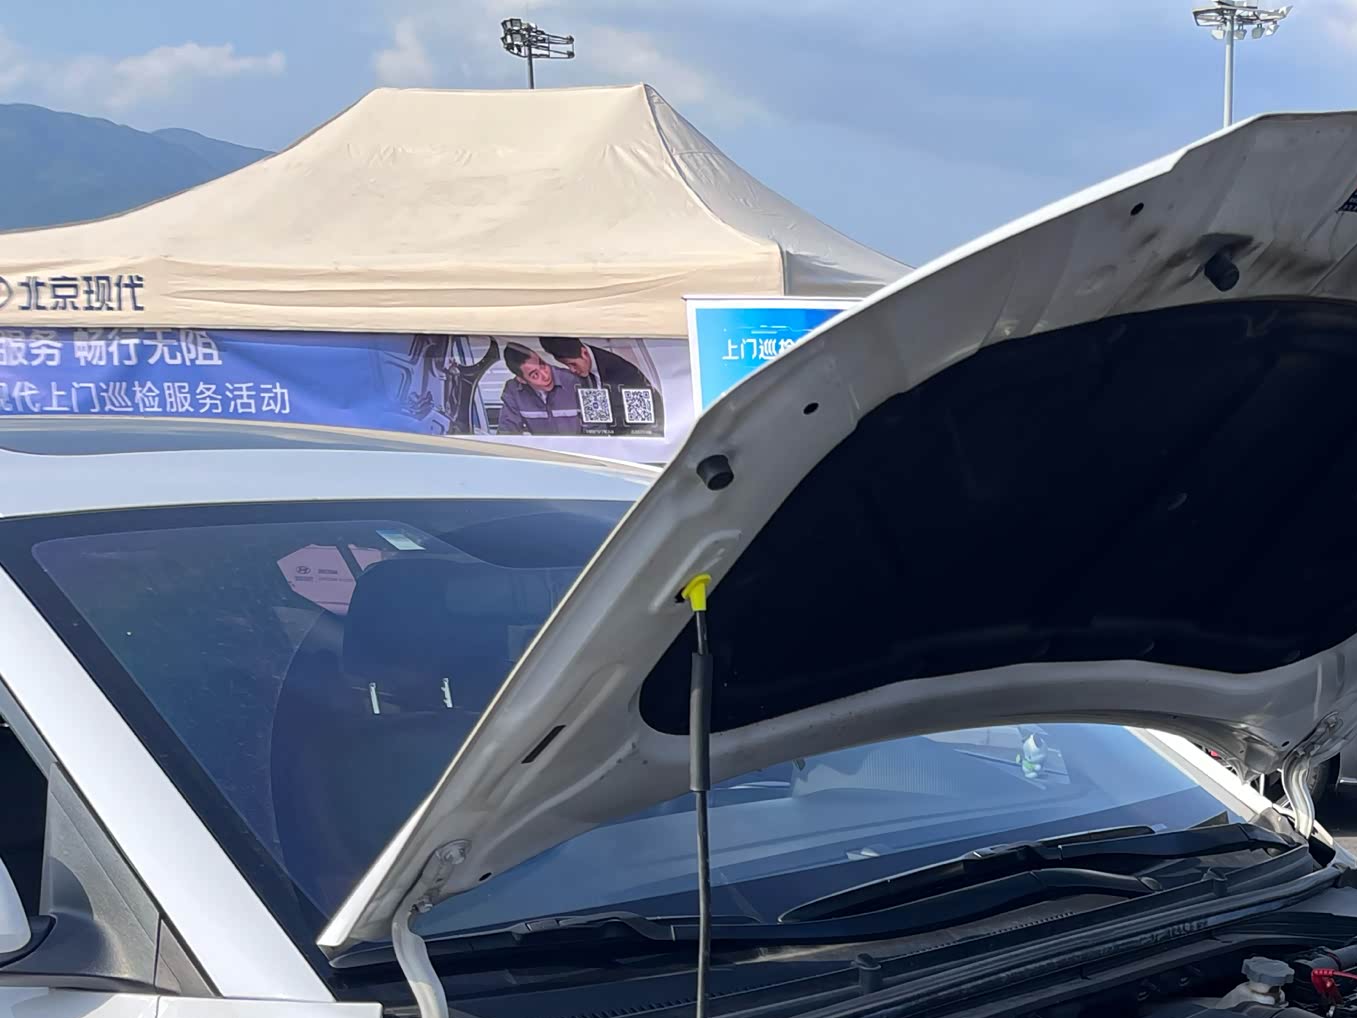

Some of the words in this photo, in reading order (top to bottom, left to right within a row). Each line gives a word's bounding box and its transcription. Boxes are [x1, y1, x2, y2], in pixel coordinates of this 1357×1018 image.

[18, 275, 144, 311] 北京现代
[73, 328, 222, 366] 畅行无阻
